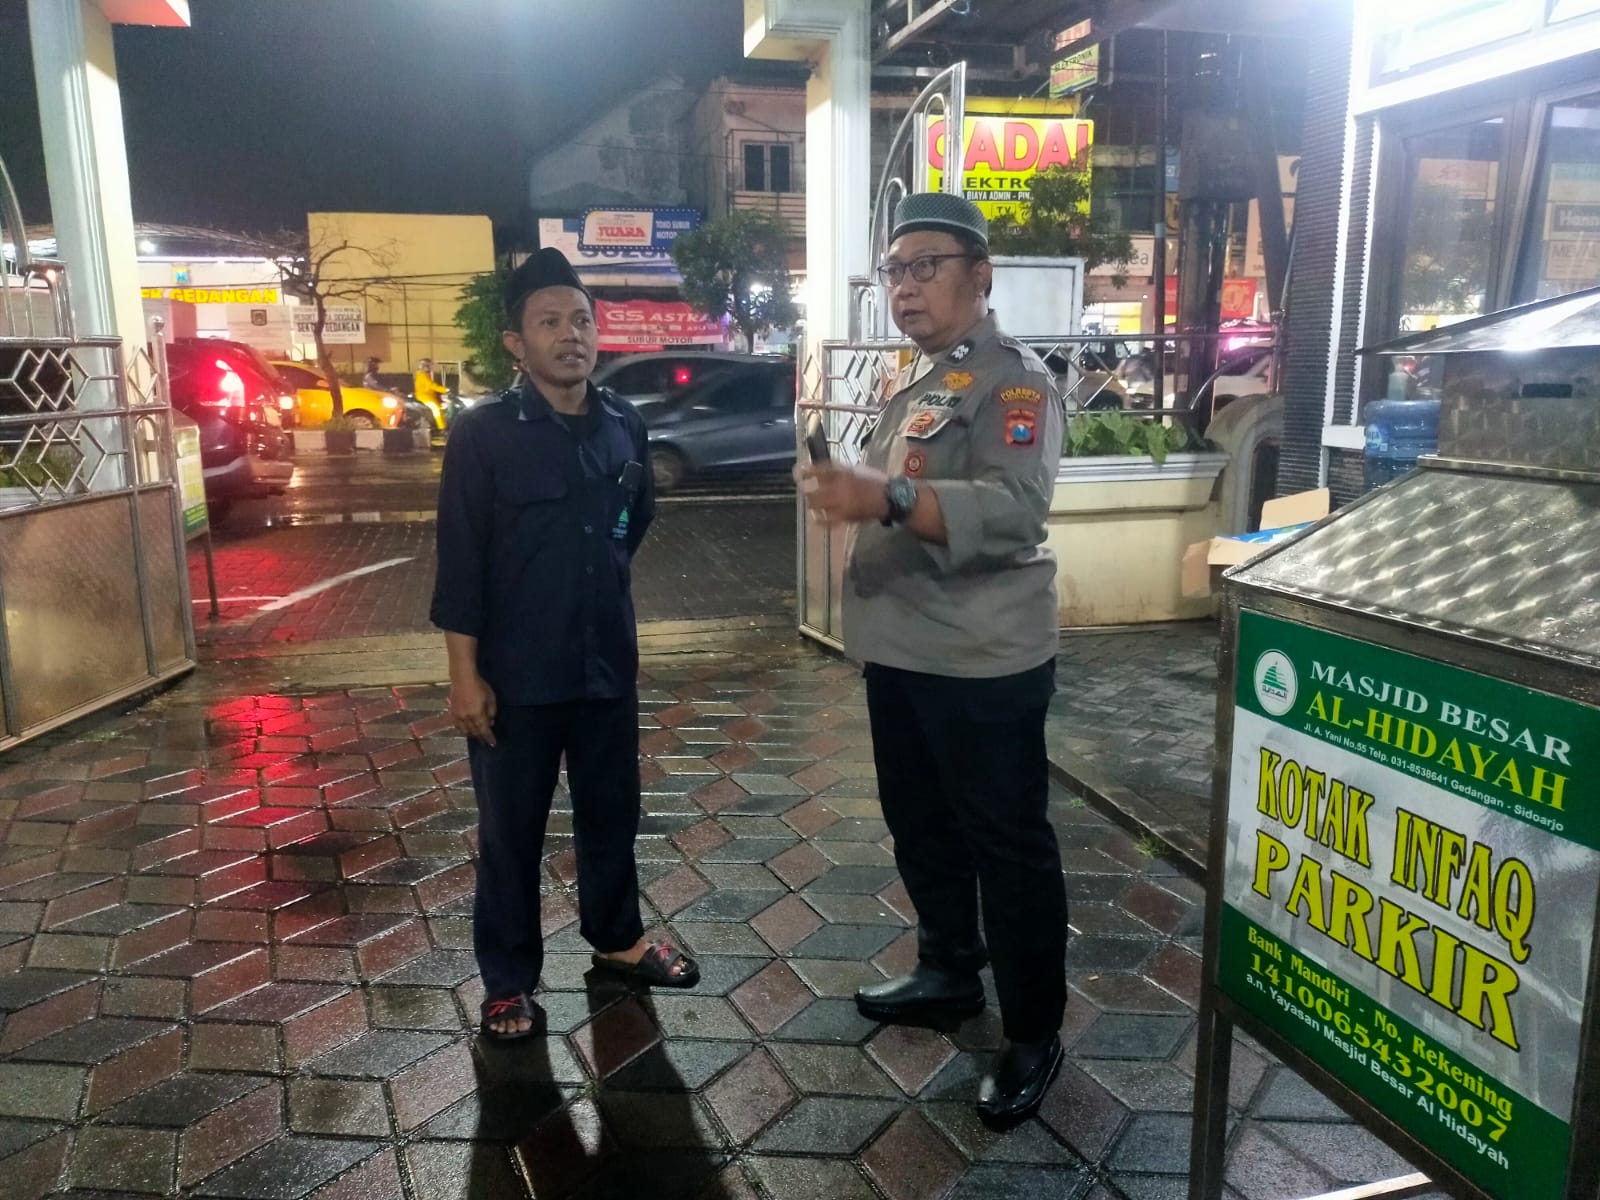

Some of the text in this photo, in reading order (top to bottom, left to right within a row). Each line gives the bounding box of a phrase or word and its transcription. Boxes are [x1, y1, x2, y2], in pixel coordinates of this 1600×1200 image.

[966, 190, 988, 200] BIAYA
[989, 191, 1011, 201] ADMIN
[170, 288, 278, 304] GEDANGAN
[605, 310, 645, 321] GS
[1306, 690, 1569, 812] AL-HIDAYAH
[1310, 660, 1572, 768] MASJID BESAR
[1314, 726, 1323, 737] A.
[1325, 730, 1342, 744] Yani
[1343, 737, 1367, 753] No.55
[1369, 747, 1388, 762] Telp.
[1450, 779, 1504, 809] Gedangan
[1514, 805, 1564, 832] Sidoarjo
[1256, 747, 1536, 965] KOTAK INFAQ
[1252, 829, 1520, 1052] PARKIR
[1246, 973, 1509, 1170] a.n. Yayasan Masjid Besar Al Hidayah
[1248, 926, 1283, 962] Bank
[1291, 954, 1350, 1008] Mandiri
[1374, 1010, 1402, 1043] No.
[1412, 1035, 1513, 1121] Rekening
[1251, 953, 1508, 1143] 1410065432007
